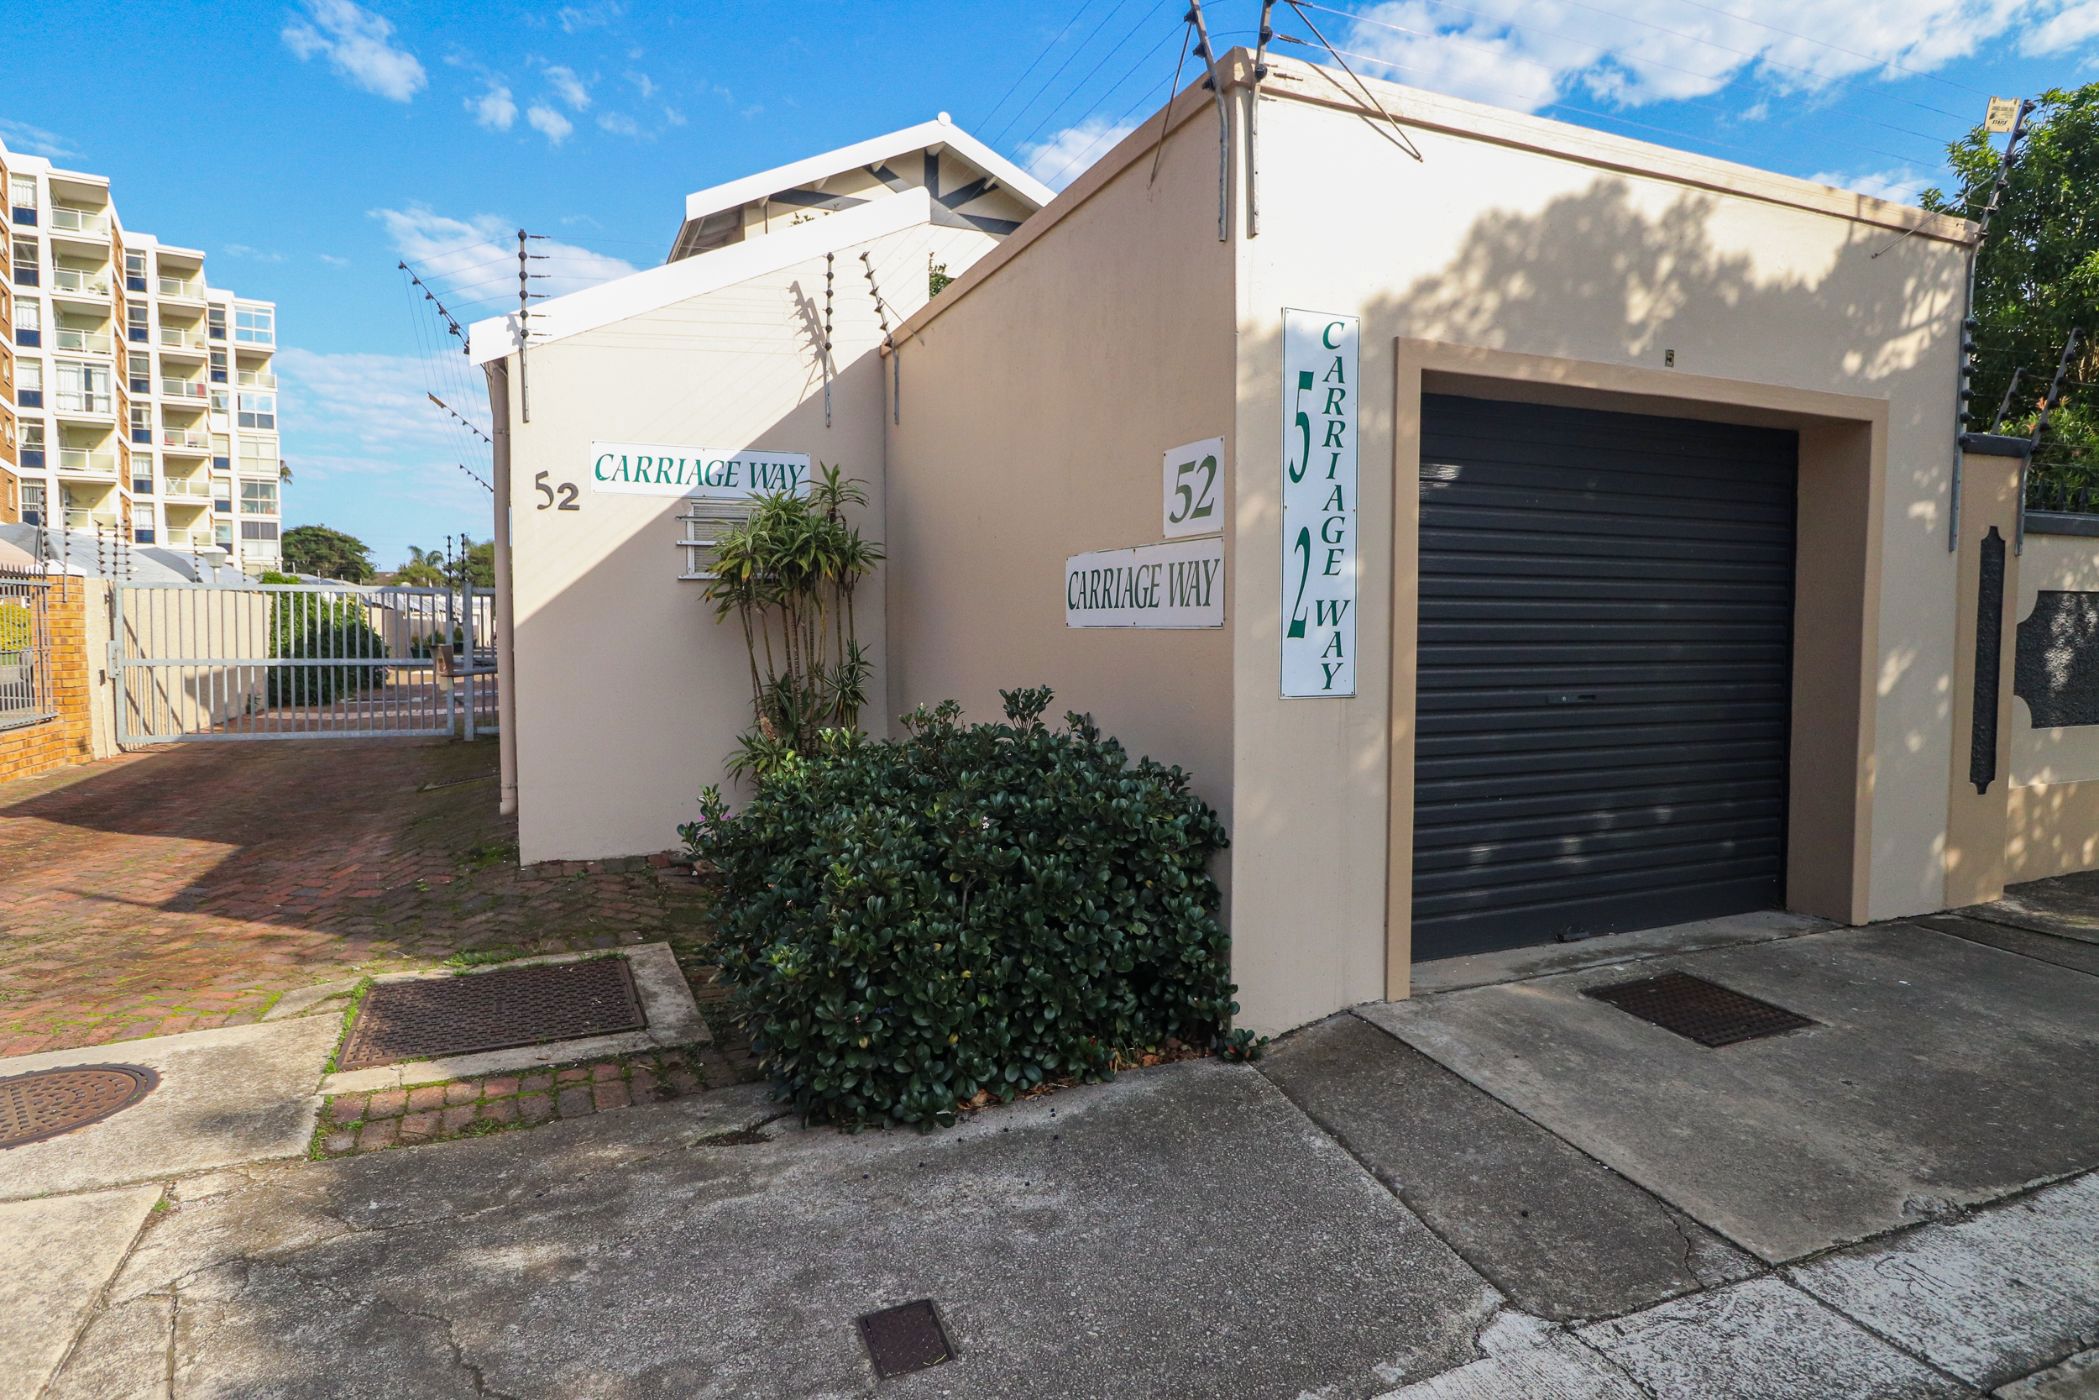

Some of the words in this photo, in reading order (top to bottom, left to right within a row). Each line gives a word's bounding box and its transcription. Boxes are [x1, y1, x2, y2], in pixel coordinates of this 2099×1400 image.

[595, 453, 742, 488] CARRIAGE
[749, 461, 806, 491] WAY
[1321, 321, 1346, 576] CARRIAGE
[535, 470, 580, 511] 52
[1169, 455, 1217, 524] 52
[1067, 562, 1163, 611] CARRIAGE
[1168, 558, 1221, 608] WAY
[1315, 599, 1350, 690] WAY
